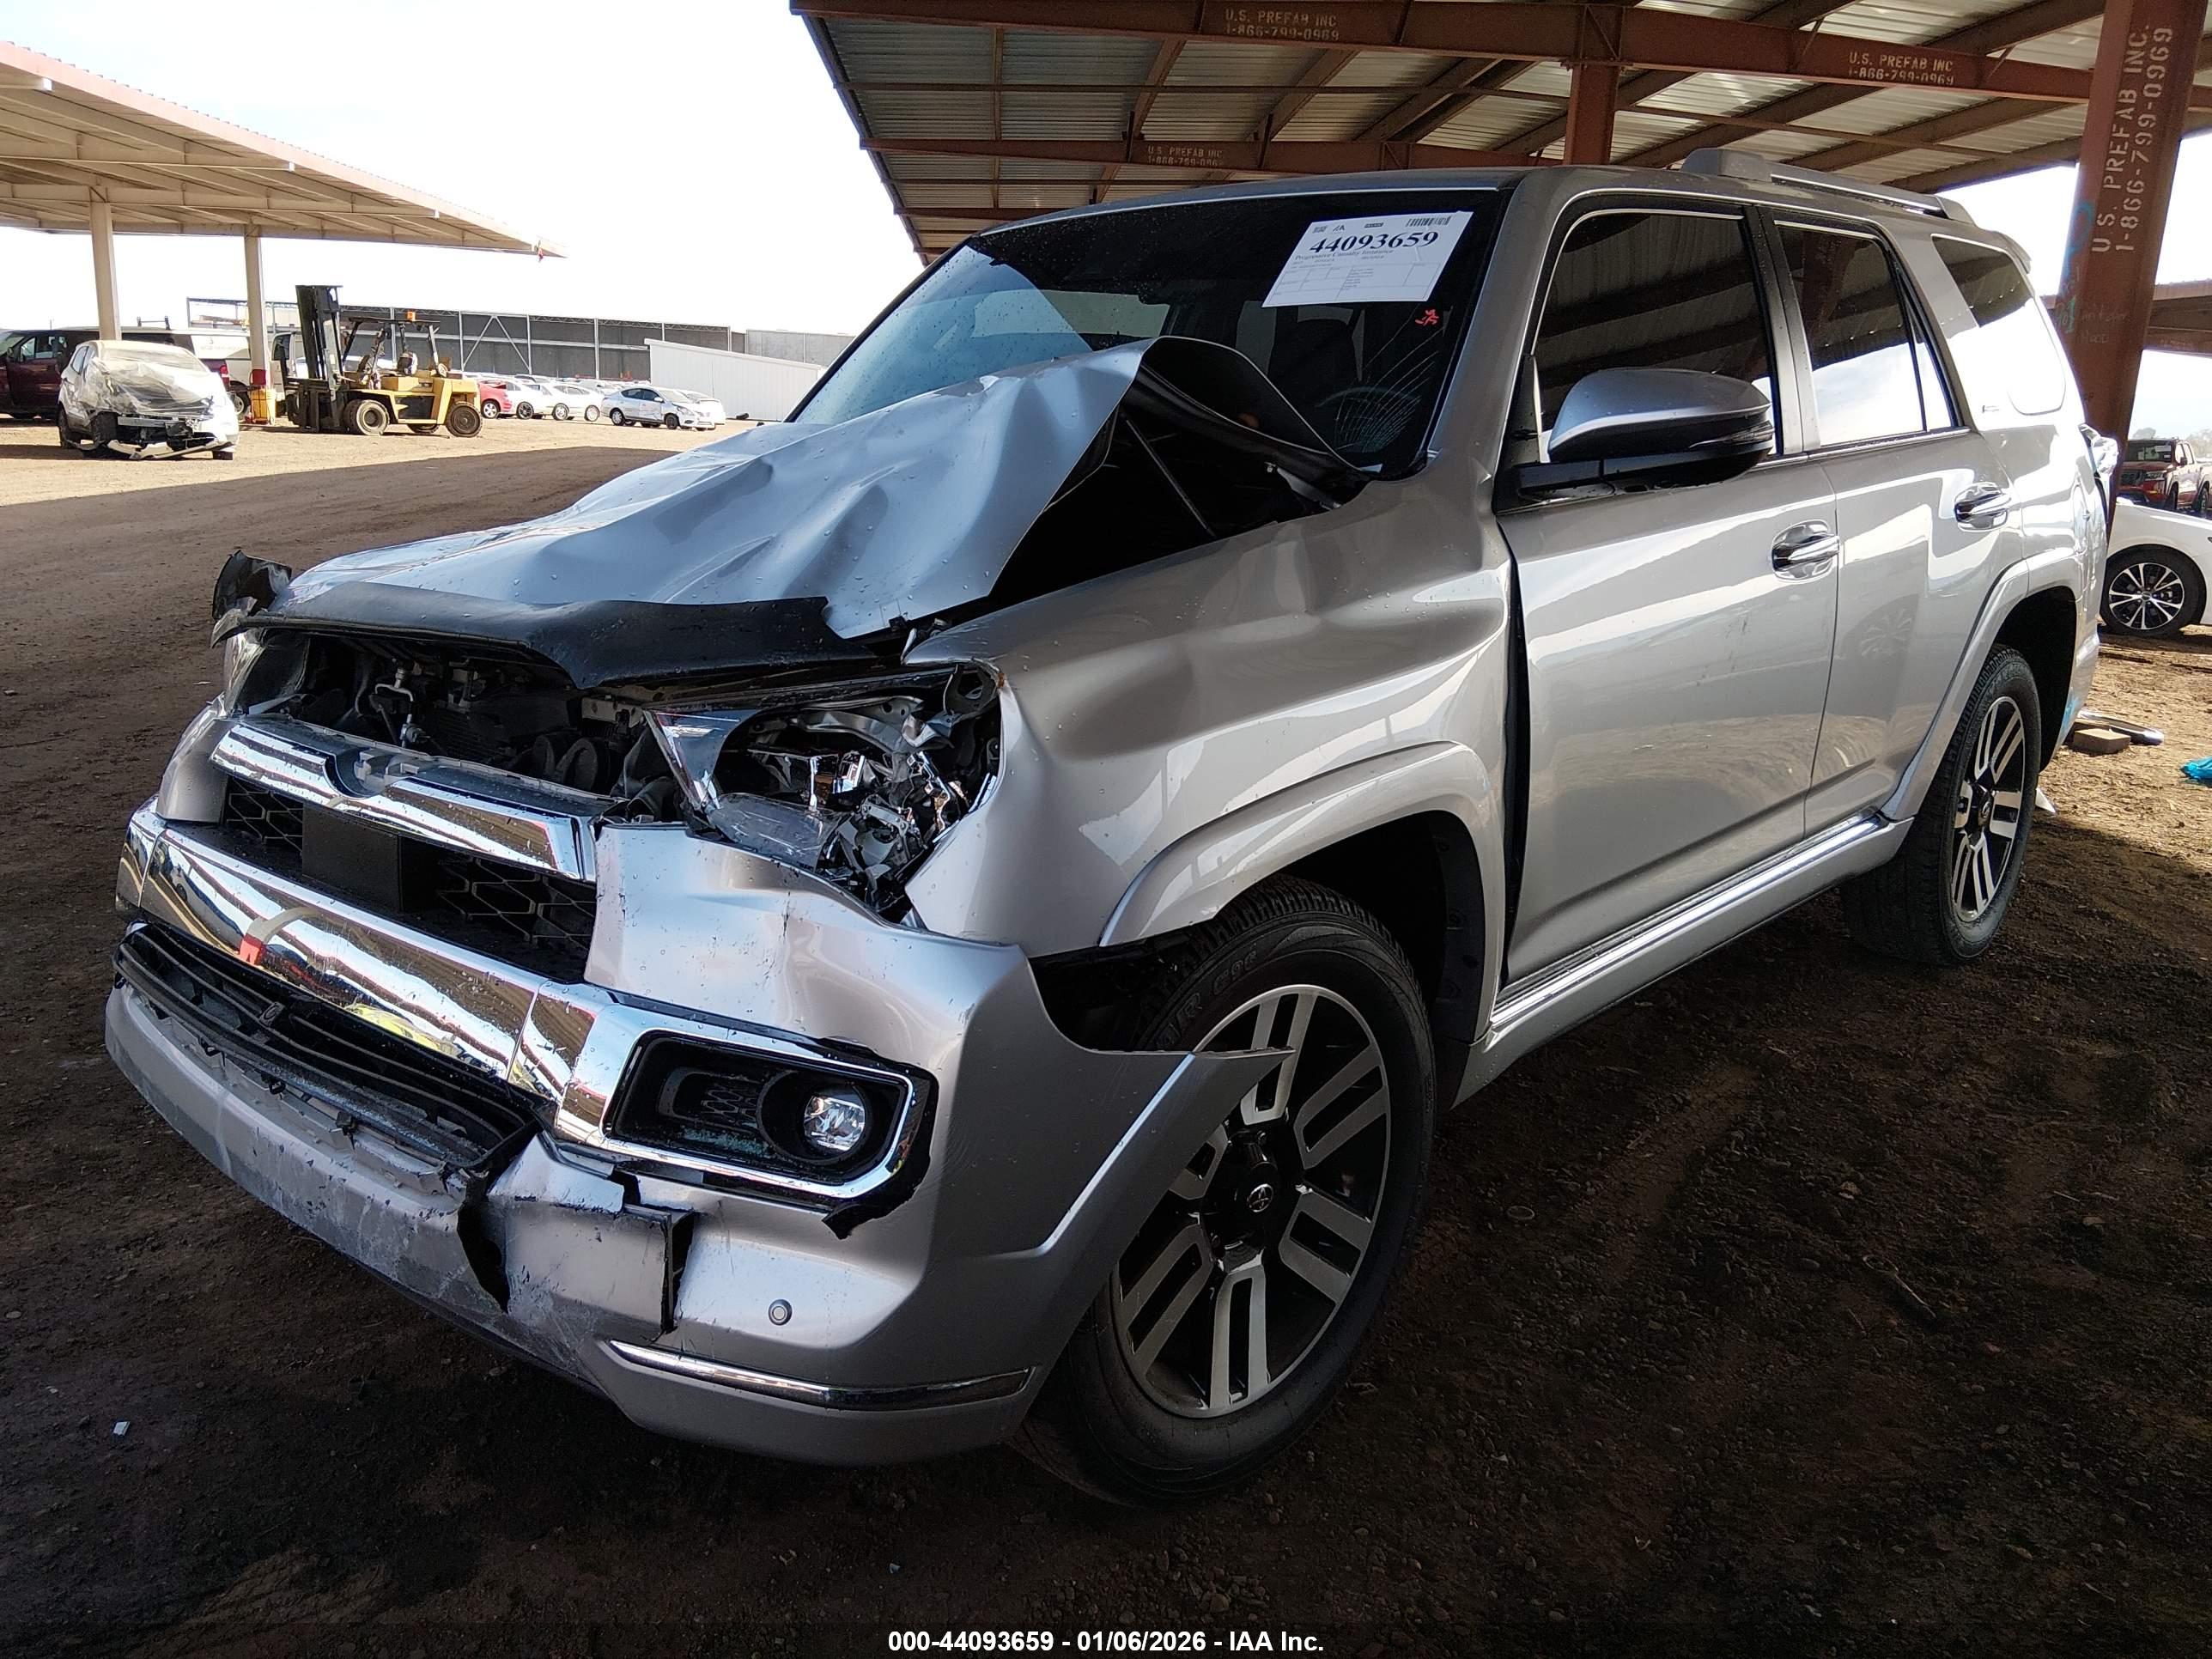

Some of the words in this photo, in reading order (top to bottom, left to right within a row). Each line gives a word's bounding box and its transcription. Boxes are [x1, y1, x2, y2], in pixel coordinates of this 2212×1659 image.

[1225, 9, 1250, 22] U.S.
[1258, 11, 1310, 25] PREFAB
[1316, 15, 1337, 27] INC
[1849, 52, 1873, 66] U.S.
[1880, 55, 1928, 69] PREFAB
[1933, 59, 1954, 72] INC
[2104, 88, 2138, 190] PREFAB
[2124, 24, 2150, 74] INC.
[2115, 27, 2173, 252] 1-866-799-0969
[1310, 231, 1439, 253] 44093659
